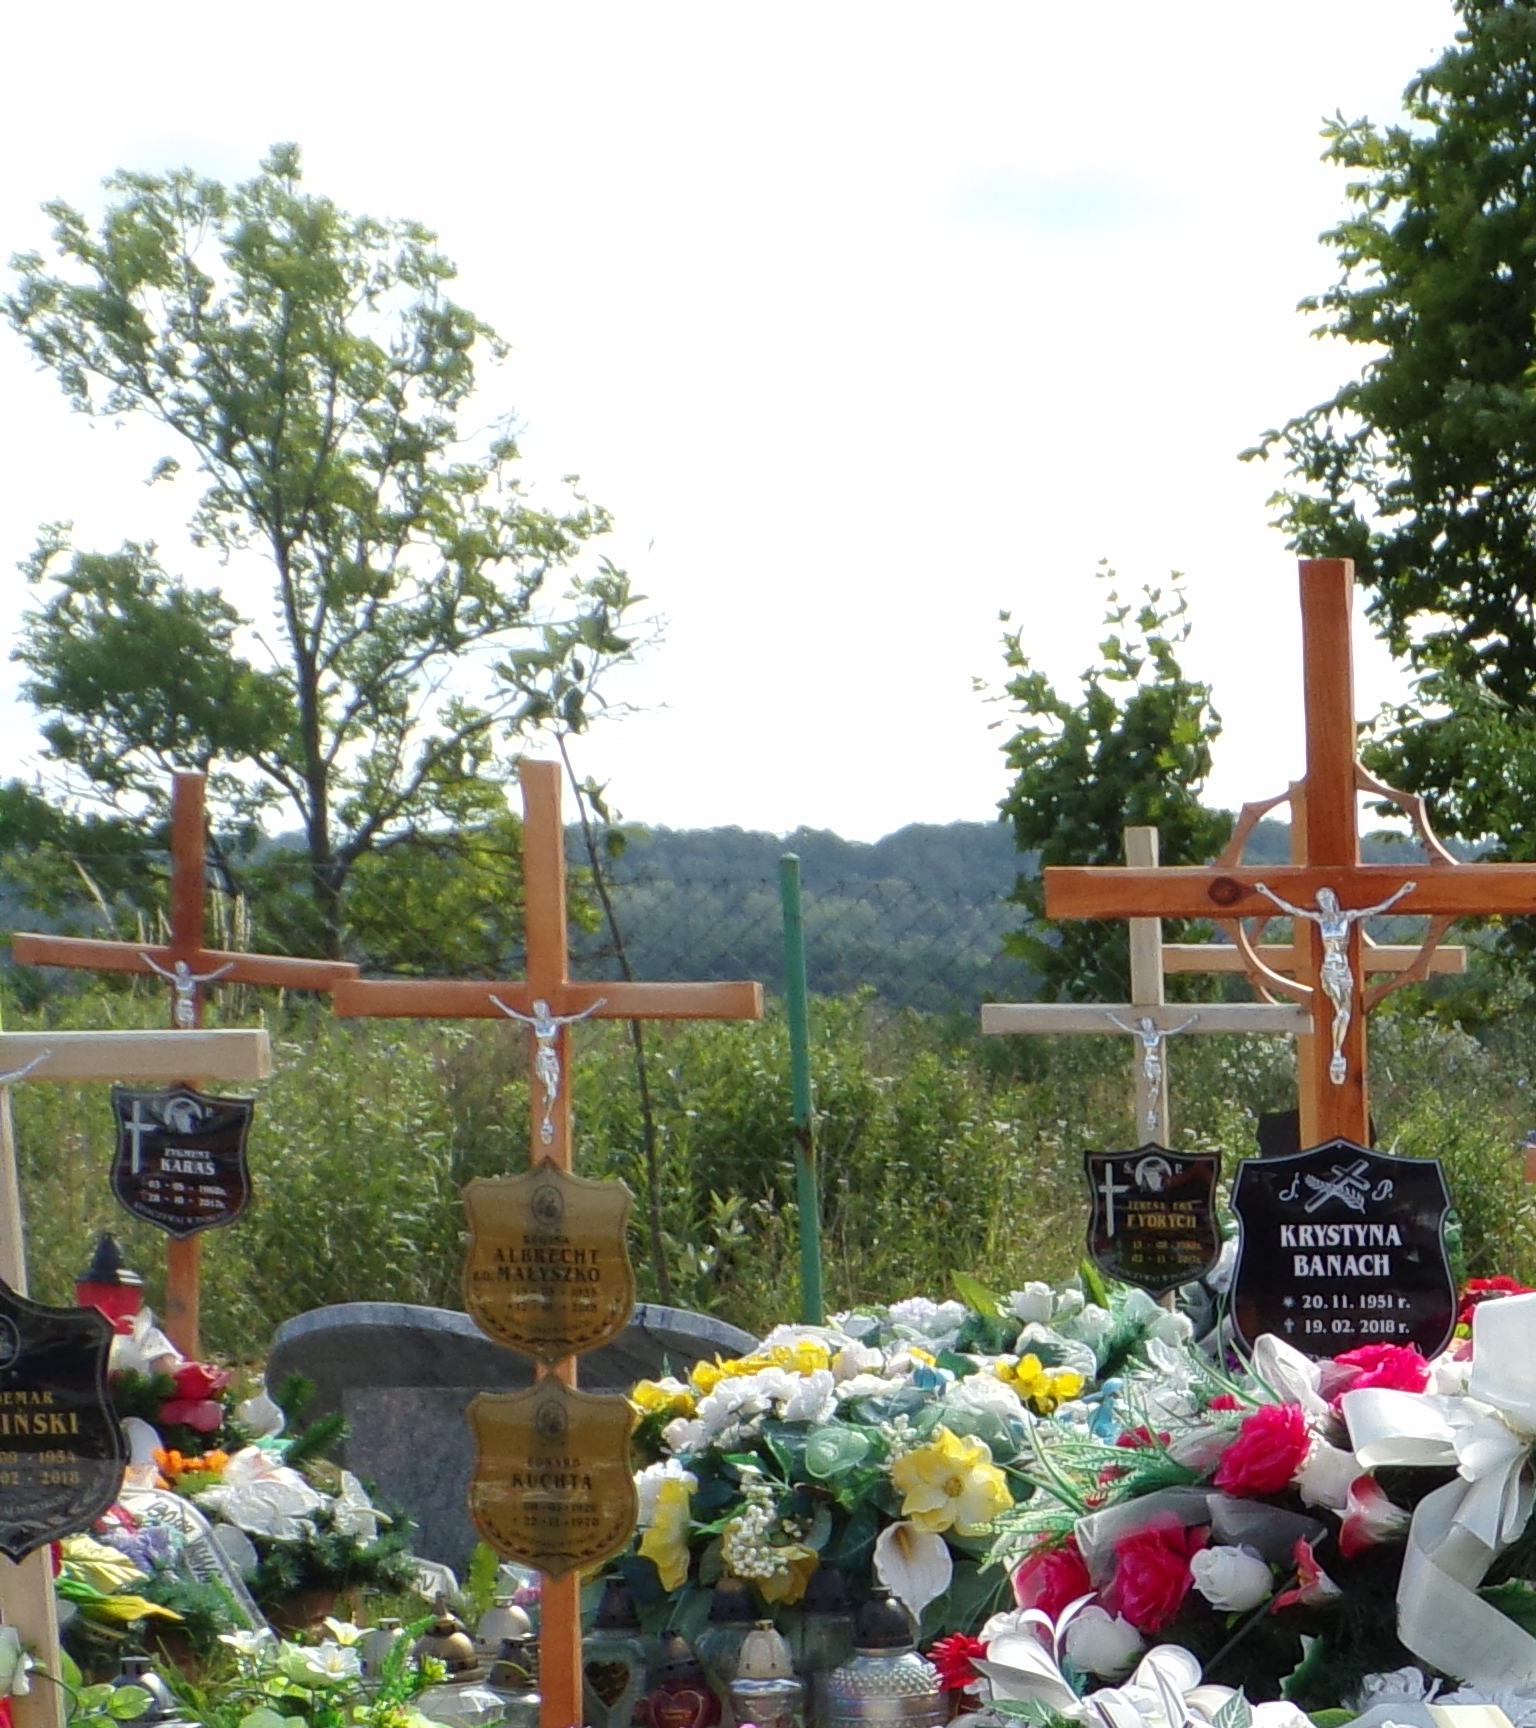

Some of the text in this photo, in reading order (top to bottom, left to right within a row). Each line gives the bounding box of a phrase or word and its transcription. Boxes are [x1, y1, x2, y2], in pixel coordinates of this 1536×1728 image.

[1372, 1179, 1394, 1201] P.
[1280, 1224, 1402, 1248] KRYSTYNA
[1293, 1254, 1391, 1277] BANACH
[1360, 1319, 1396, 1333] 2018
[512, 1473, 593, 1490] KUCHTA
